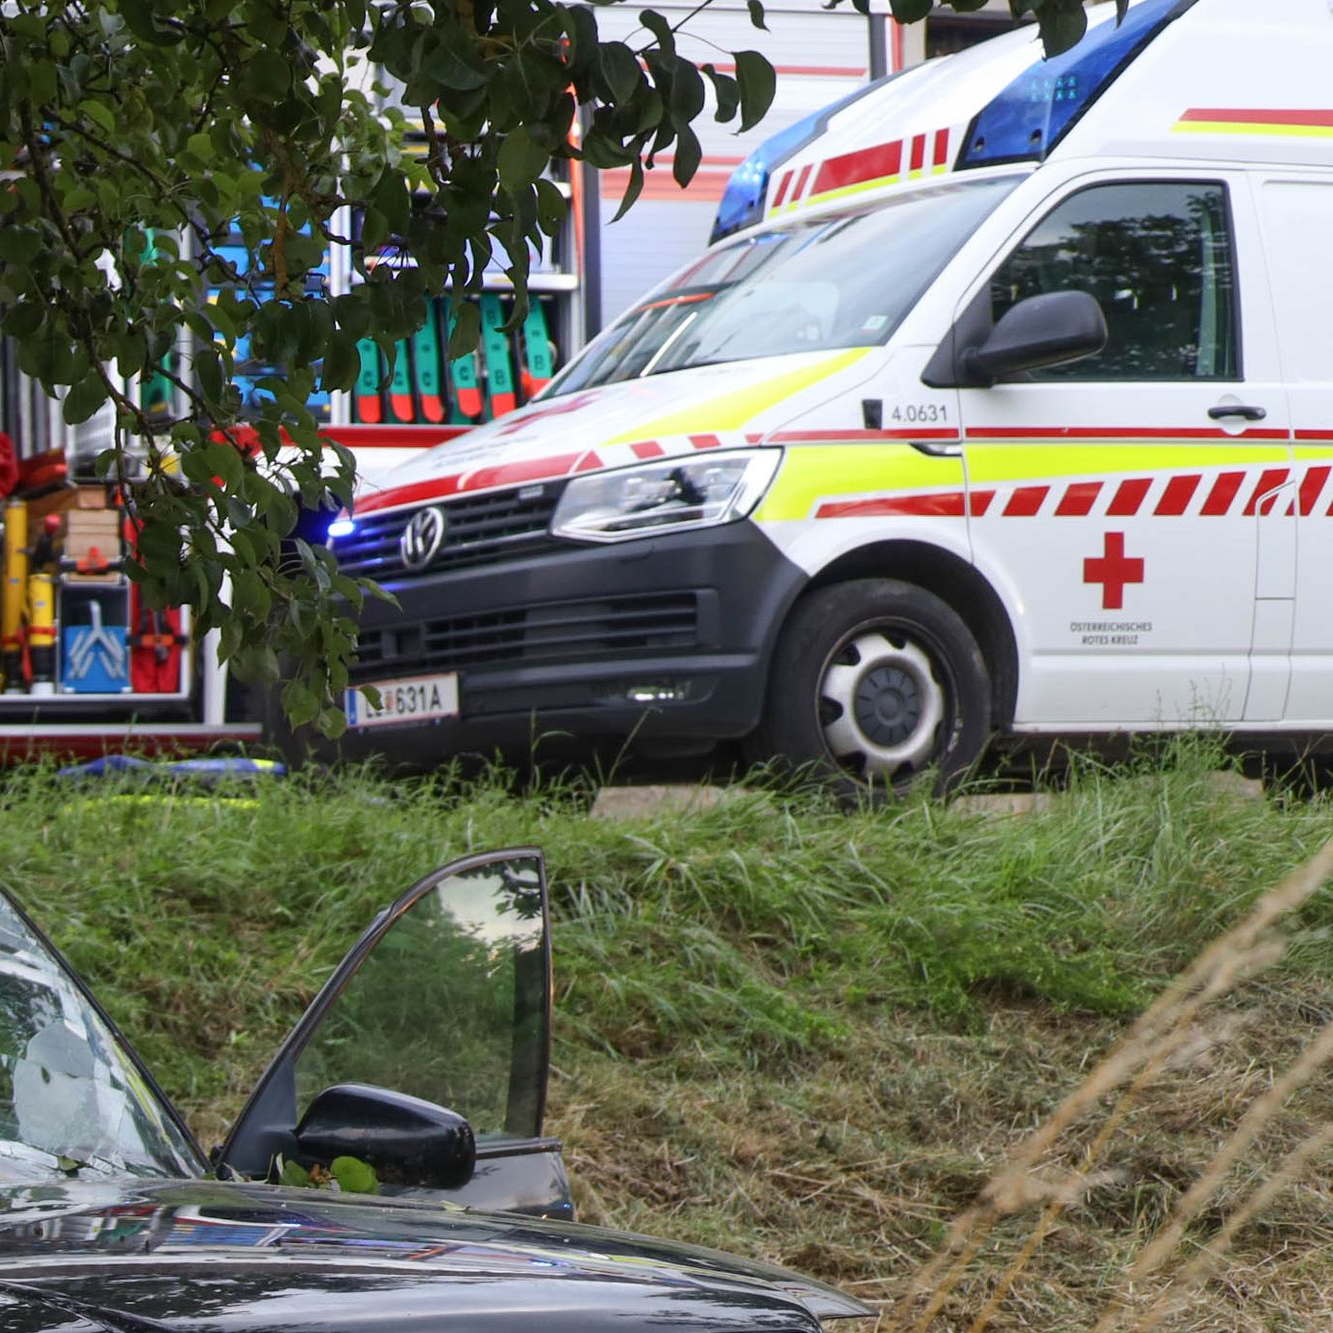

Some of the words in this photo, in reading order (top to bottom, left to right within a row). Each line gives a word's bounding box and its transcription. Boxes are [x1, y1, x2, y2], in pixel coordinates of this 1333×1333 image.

[891, 404, 948, 422] 4.0631
[1082, 635, 1109, 645] ROTES
[1111, 634, 1139, 645] KREUZ
[395, 684, 442, 714] 631A
